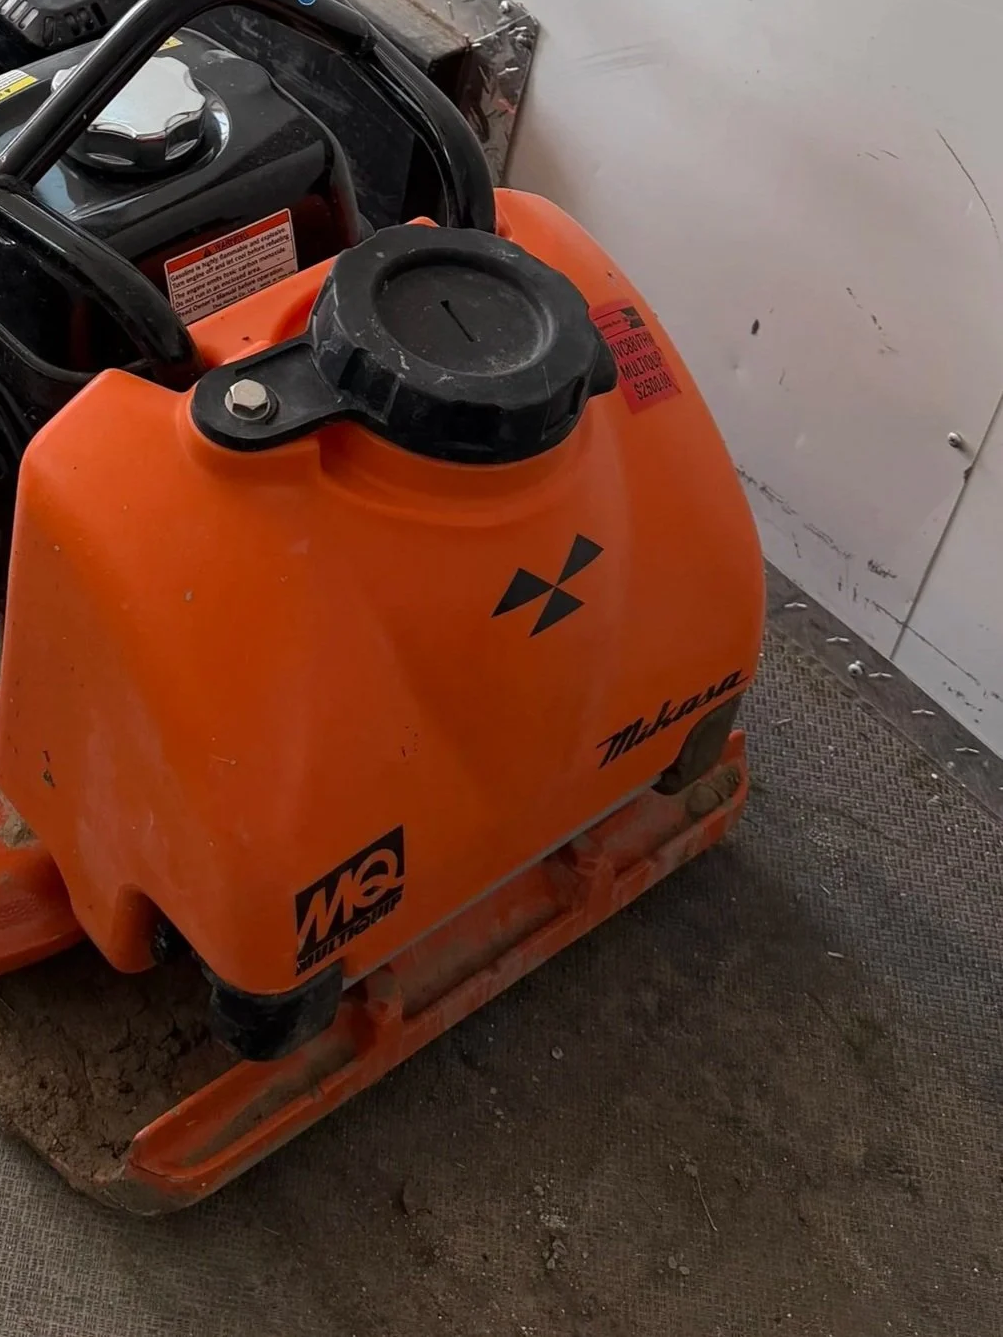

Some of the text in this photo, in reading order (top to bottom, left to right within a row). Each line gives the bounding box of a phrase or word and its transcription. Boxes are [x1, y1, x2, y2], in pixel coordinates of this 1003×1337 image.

[169, 265, 194, 282] Gasoline
[194, 263, 200, 271] is
[201, 255, 219, 270] highly
[218, 242, 248, 260] flammable
[248, 237, 259, 247] and
[171, 278, 184, 290] Turn
[185, 270, 204, 284] engine
[204, 265, 213, 275] off
[214, 260, 225, 270] and
[225, 257, 234, 265] let
[234, 251, 246, 262] cool
[247, 243, 264, 256] before
[173, 290, 185, 300] The
[185, 281, 205, 296] engine
[205, 274, 222, 286] emits
[237, 257, 258, 271] carbon
[174, 299, 184, 309] Do
[184, 294, 194, 304] not
[194, 290, 205, 299] run
[212, 283, 220, 291] an
[220, 271, 246, 287] enclosed
[192, 296, 215, 311] Owner's
[215, 286, 237, 301] Manual
[237, 278, 253, 291] before
[596, 668, 749, 769] Mikasa
[297, 849, 405, 955] MQ
